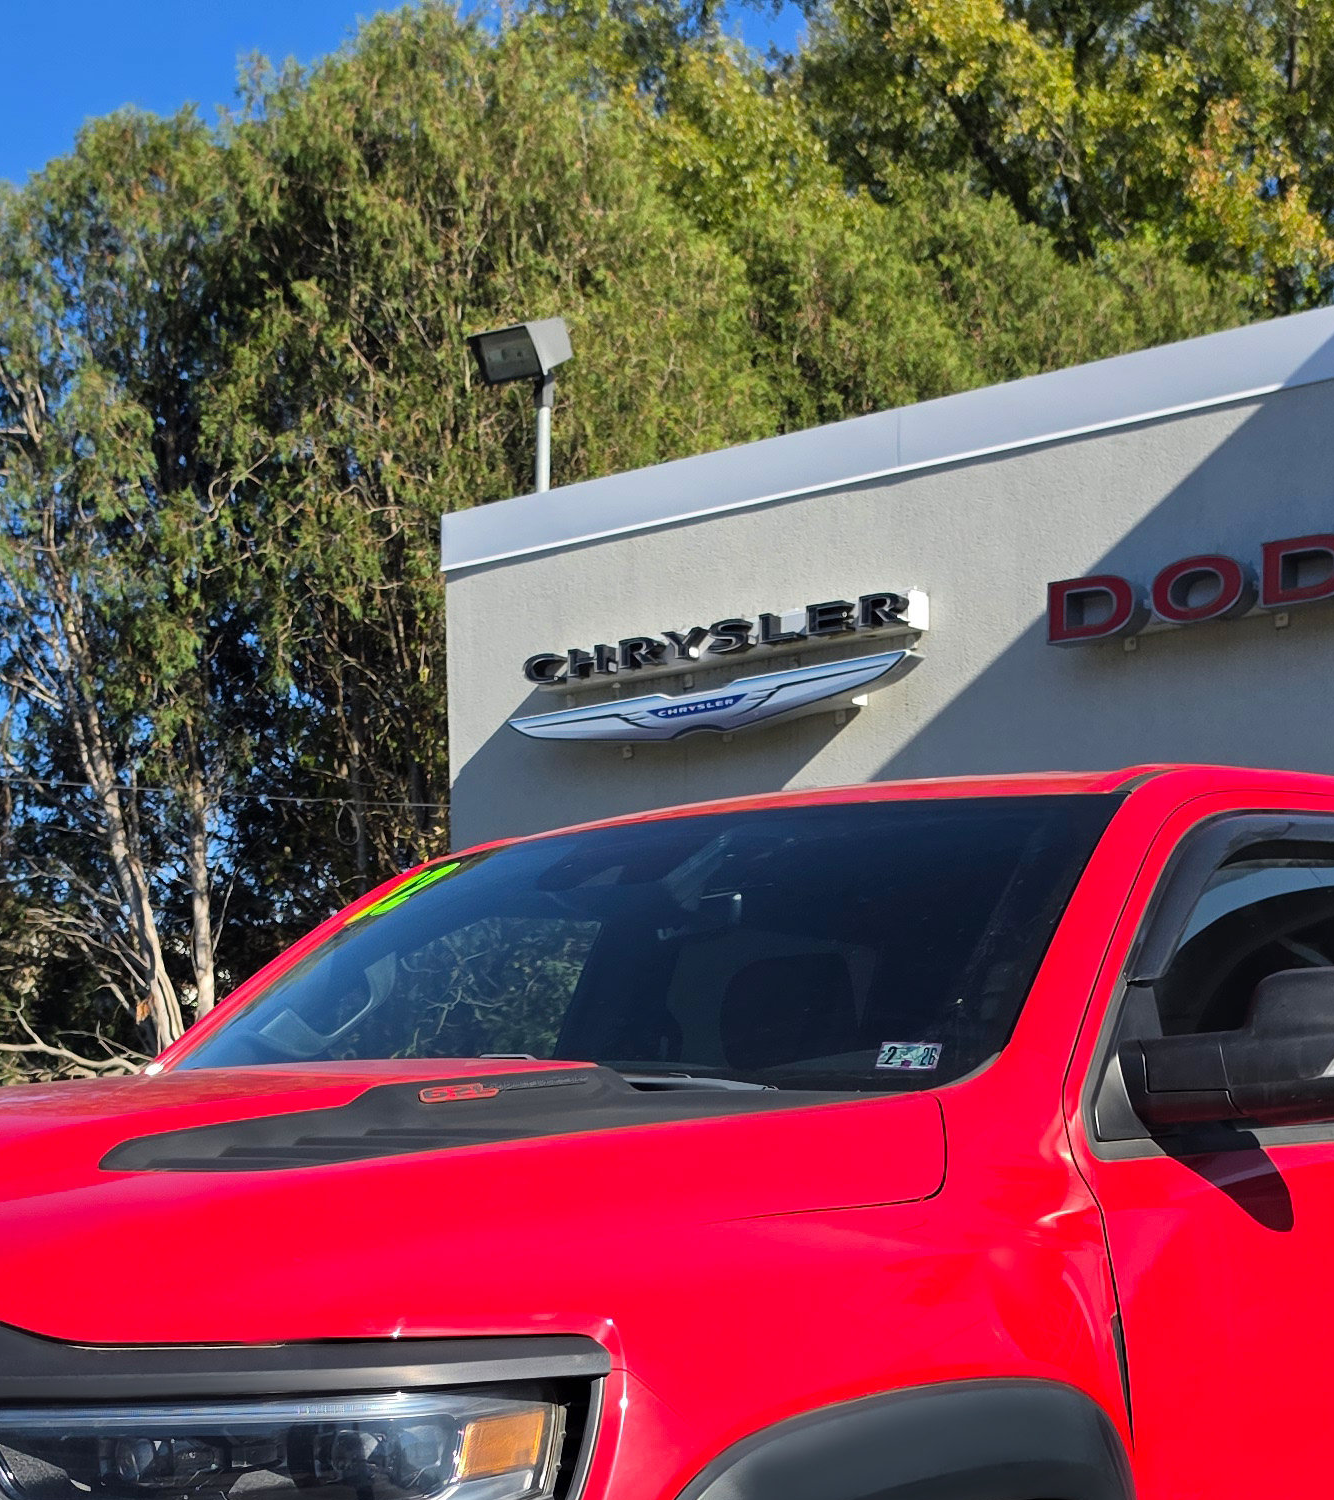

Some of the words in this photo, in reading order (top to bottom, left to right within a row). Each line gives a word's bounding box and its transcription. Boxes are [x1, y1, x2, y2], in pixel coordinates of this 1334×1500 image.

[523, 592, 909, 684] CHRYSLER
[657, 699, 734, 717] CHRYSLER
[883, 1046, 898, 1065] 2
[920, 1047, 938, 1066] 26
